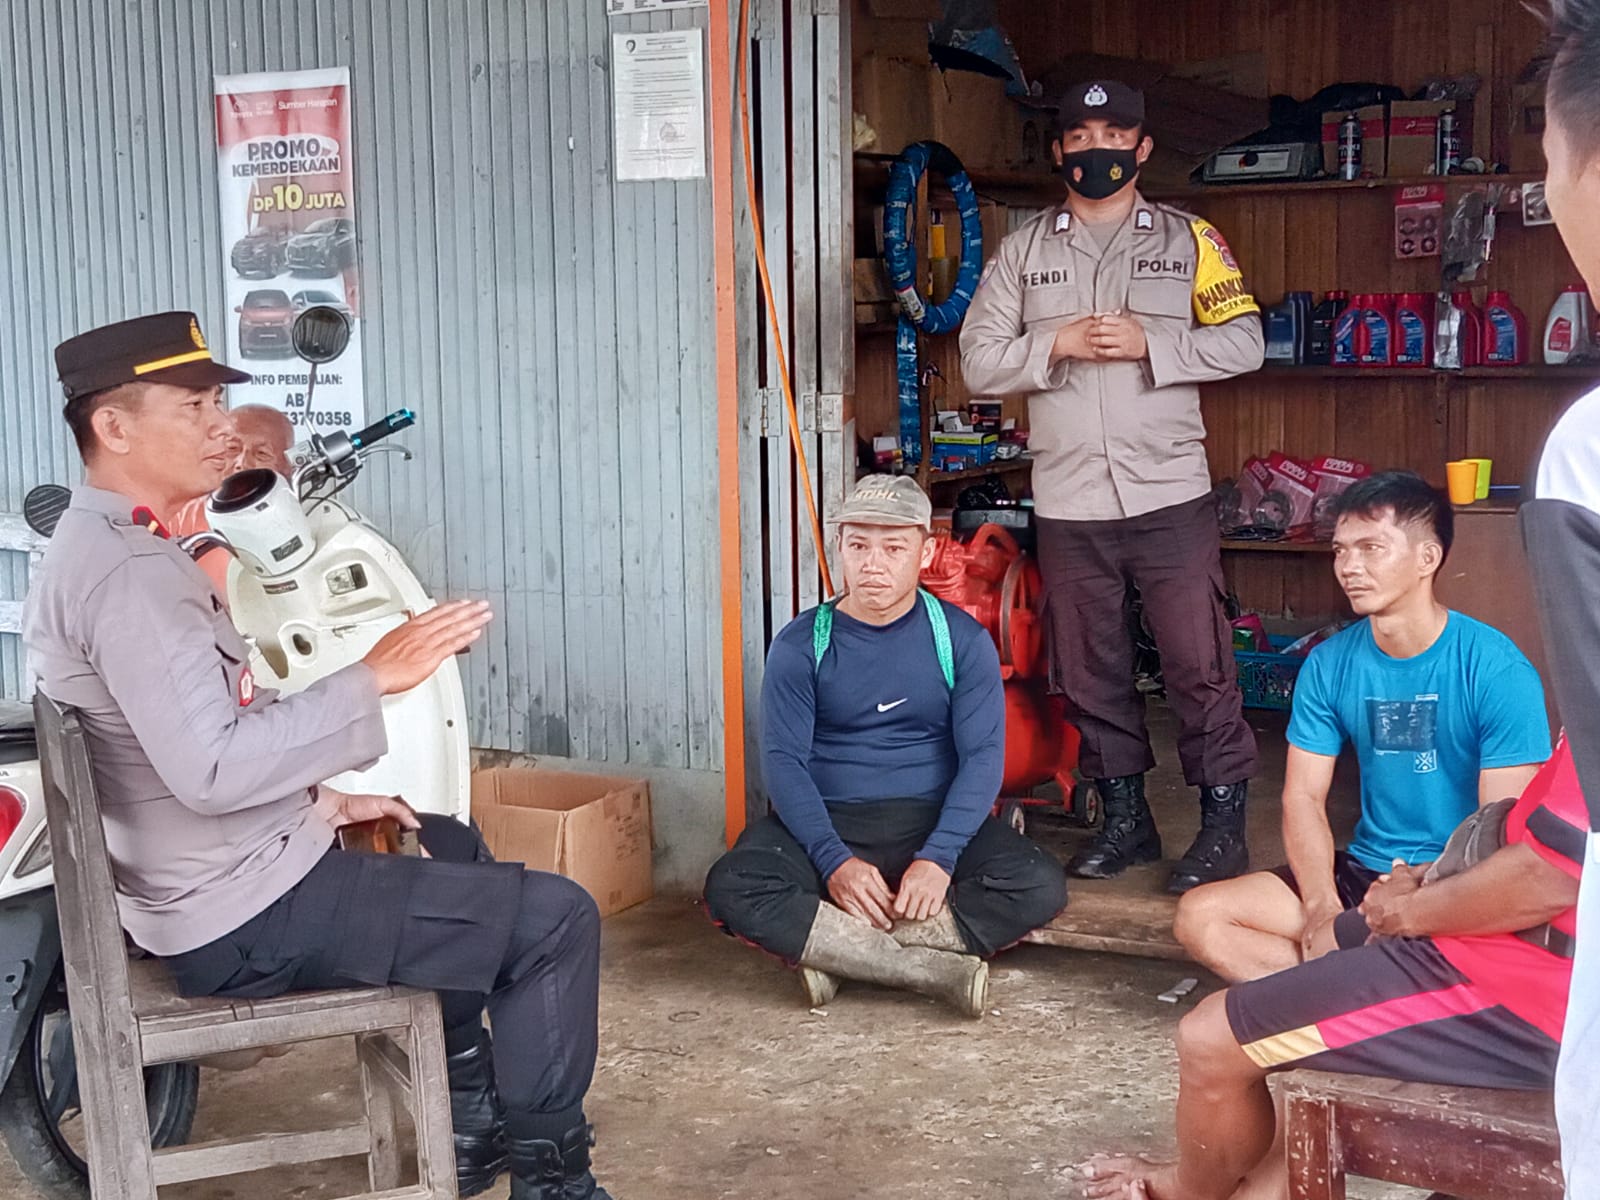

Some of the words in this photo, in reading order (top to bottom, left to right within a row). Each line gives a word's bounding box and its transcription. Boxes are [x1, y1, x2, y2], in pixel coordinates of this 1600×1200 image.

[248, 138, 321, 161] PROMO
[232, 157, 339, 178] KEMERDEKAAN
[305, 193, 346, 209] JUTA
[1137, 259, 1188, 275] POLRI
[1022, 269, 1068, 288] FENDI
[251, 374, 275, 385] INFO
[278, 374, 343, 385] PEMBLIAN:
